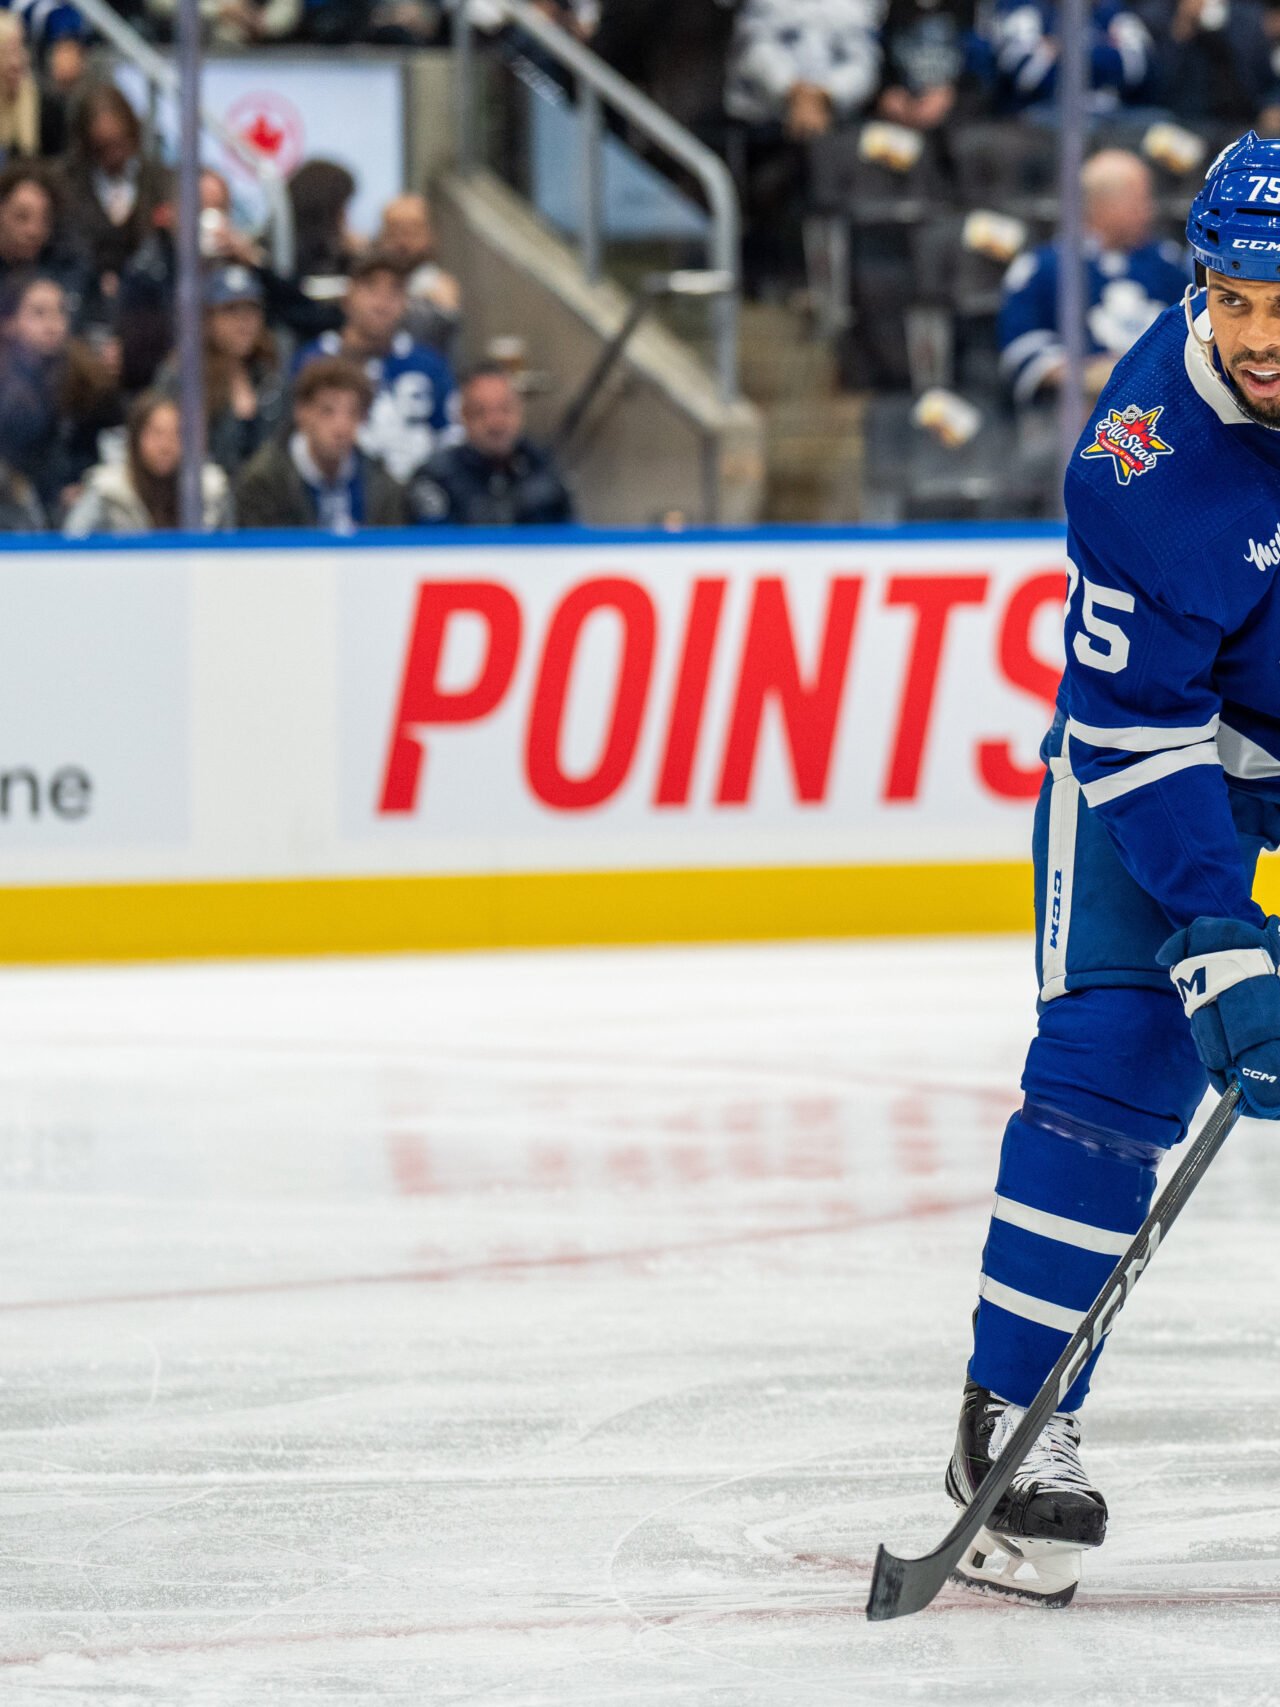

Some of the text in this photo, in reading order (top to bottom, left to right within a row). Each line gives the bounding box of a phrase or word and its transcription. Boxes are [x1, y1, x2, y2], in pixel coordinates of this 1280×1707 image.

[1119, 433, 1157, 467] Star
[377, 571, 1067, 816] POINTS
[1049, 867, 1063, 950] CCM
[1241, 1067, 1278, 1084] CCM
